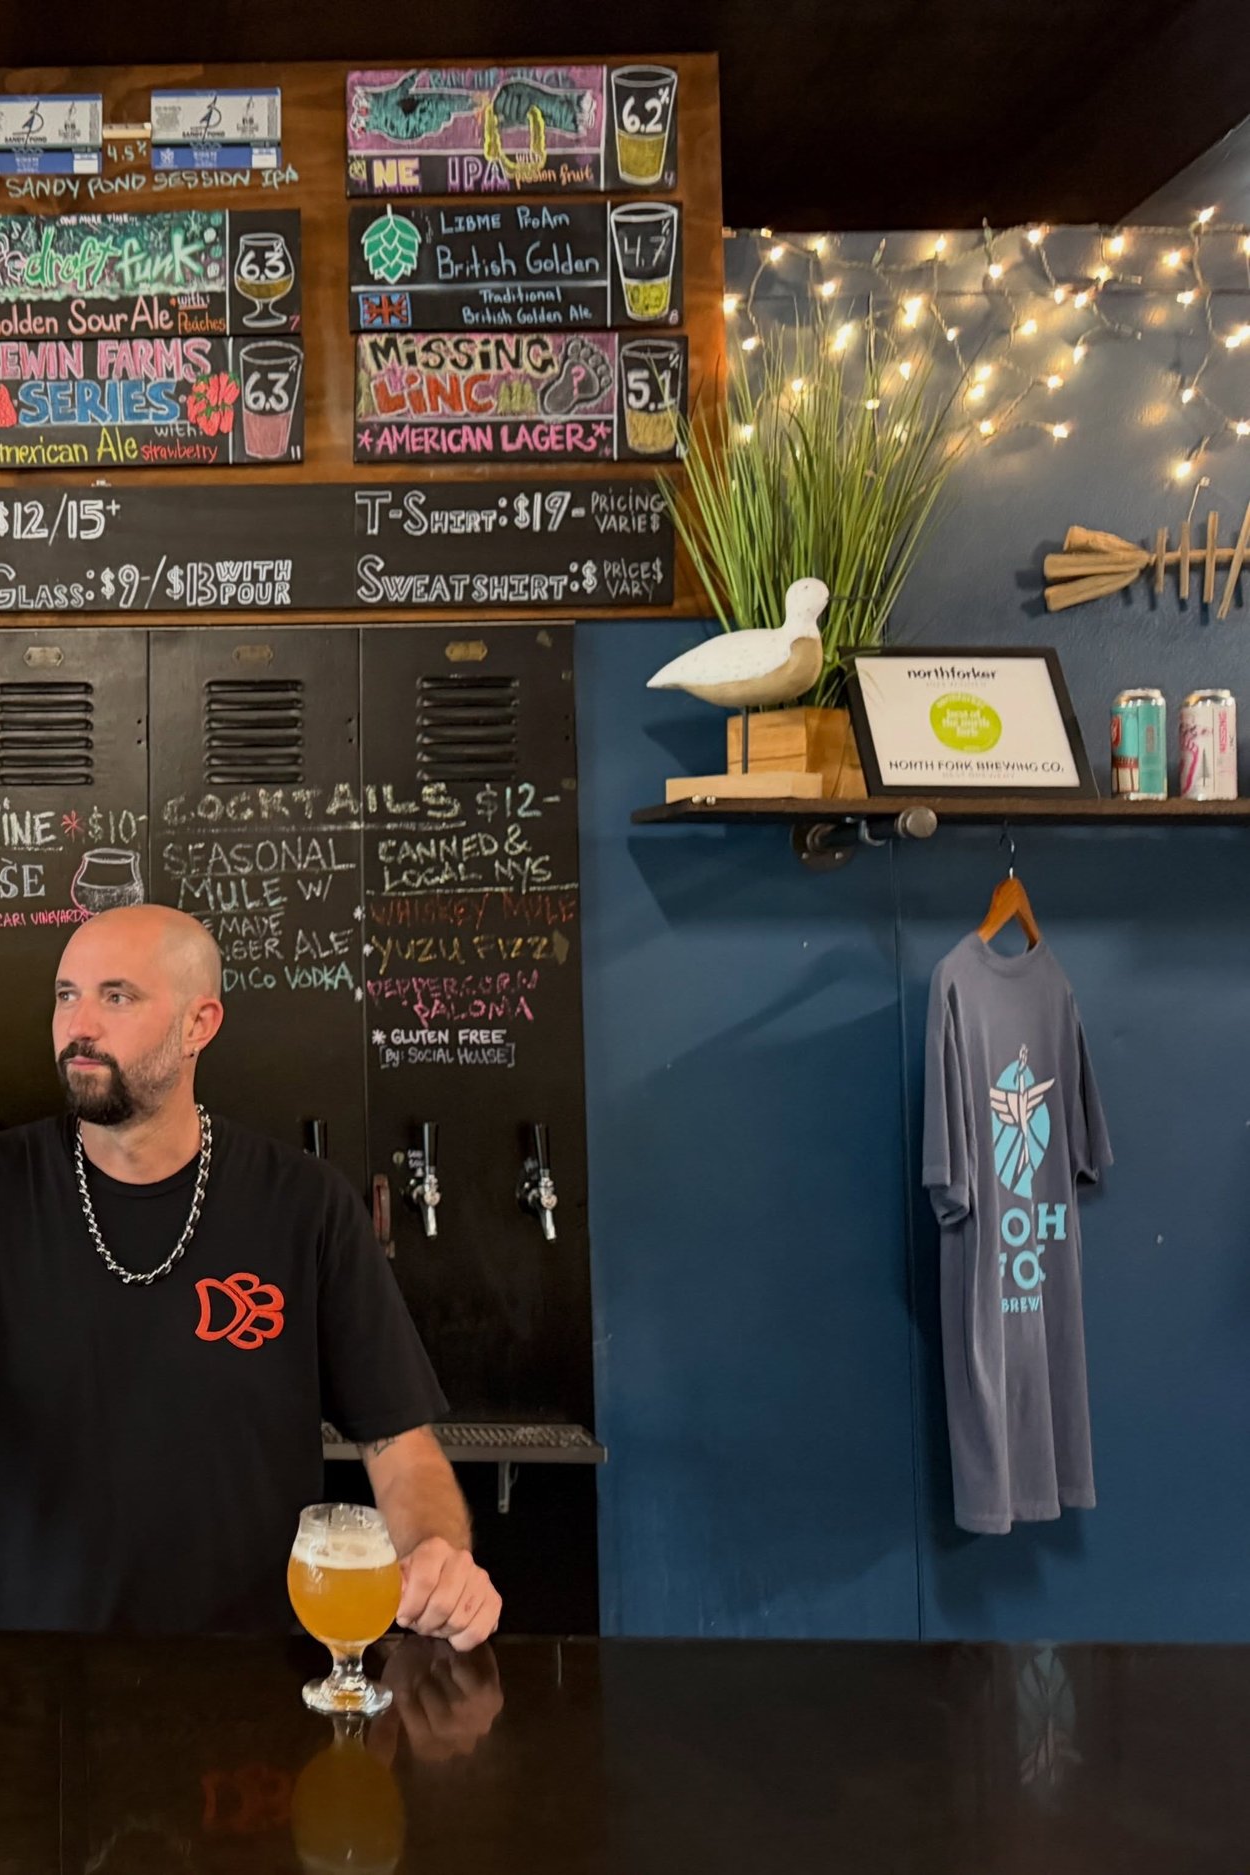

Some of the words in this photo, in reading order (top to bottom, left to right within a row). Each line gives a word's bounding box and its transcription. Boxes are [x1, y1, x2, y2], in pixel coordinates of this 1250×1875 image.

[4, 176, 81, 201] SANDY
[87, 173, 148, 199] POND
[153, 168, 251, 189] SESSION
[261, 163, 300, 190] IPA
[372, 157, 423, 191] NE
[447, 156, 512, 192] IPA
[24, 225, 122, 292] draft
[436, 240, 517, 281] British
[526, 240, 600, 276] Golden
[479, 285, 563, 304] Traditional
[67, 299, 129, 335] Sour
[130, 295, 175, 334] Ale
[177, 311, 227, 336] Peaches
[461, 305, 512, 326] British
[516, 306, 563, 325] Golden
[569, 303, 593, 322] Ale
[96, 337, 213, 381] FARMS
[363, 334, 558, 375] MISSING
[17, 379, 182, 426] SERIES
[96, 426, 139, 461] Ale
[140, 438, 220, 464] strawberry
[376, 425, 494, 454] AMERICAN
[500, 422, 598, 453] LAGER
[354, 490, 508, 537] T-SHIRT:
[589, 487, 668, 514] PRICING
[214, 560, 293, 582] WITH
[218, 581, 293, 606] POUR
[605, 580, 657, 603] VARY
[906, 666, 998, 681] northforker
[888, 760, 935, 772] NORTH
[938, 760, 973, 772] FORK
[976, 760, 1039, 773] BREWING
[1041, 761, 1065, 773] CO.
[162, 782, 463, 826] COCKTAILS
[162, 836, 356, 875] SEASONAL
[378, 832, 499, 863] CANNED
[504, 824, 532, 855] &
[383, 863, 484, 894] LOCAL
[494, 855, 552, 894] NYS
[177, 877, 288, 911] MULE
[218, 912, 286, 940] MADE
[293, 928, 354, 962] ALE
[370, 935, 466, 976] YUZU
[284, 960, 356, 991] VODKA
[390, 1028, 450, 1045] GLUTEN
[457, 1028, 508, 1044] FREE
[407, 1048, 454, 1064] SOCIAL
